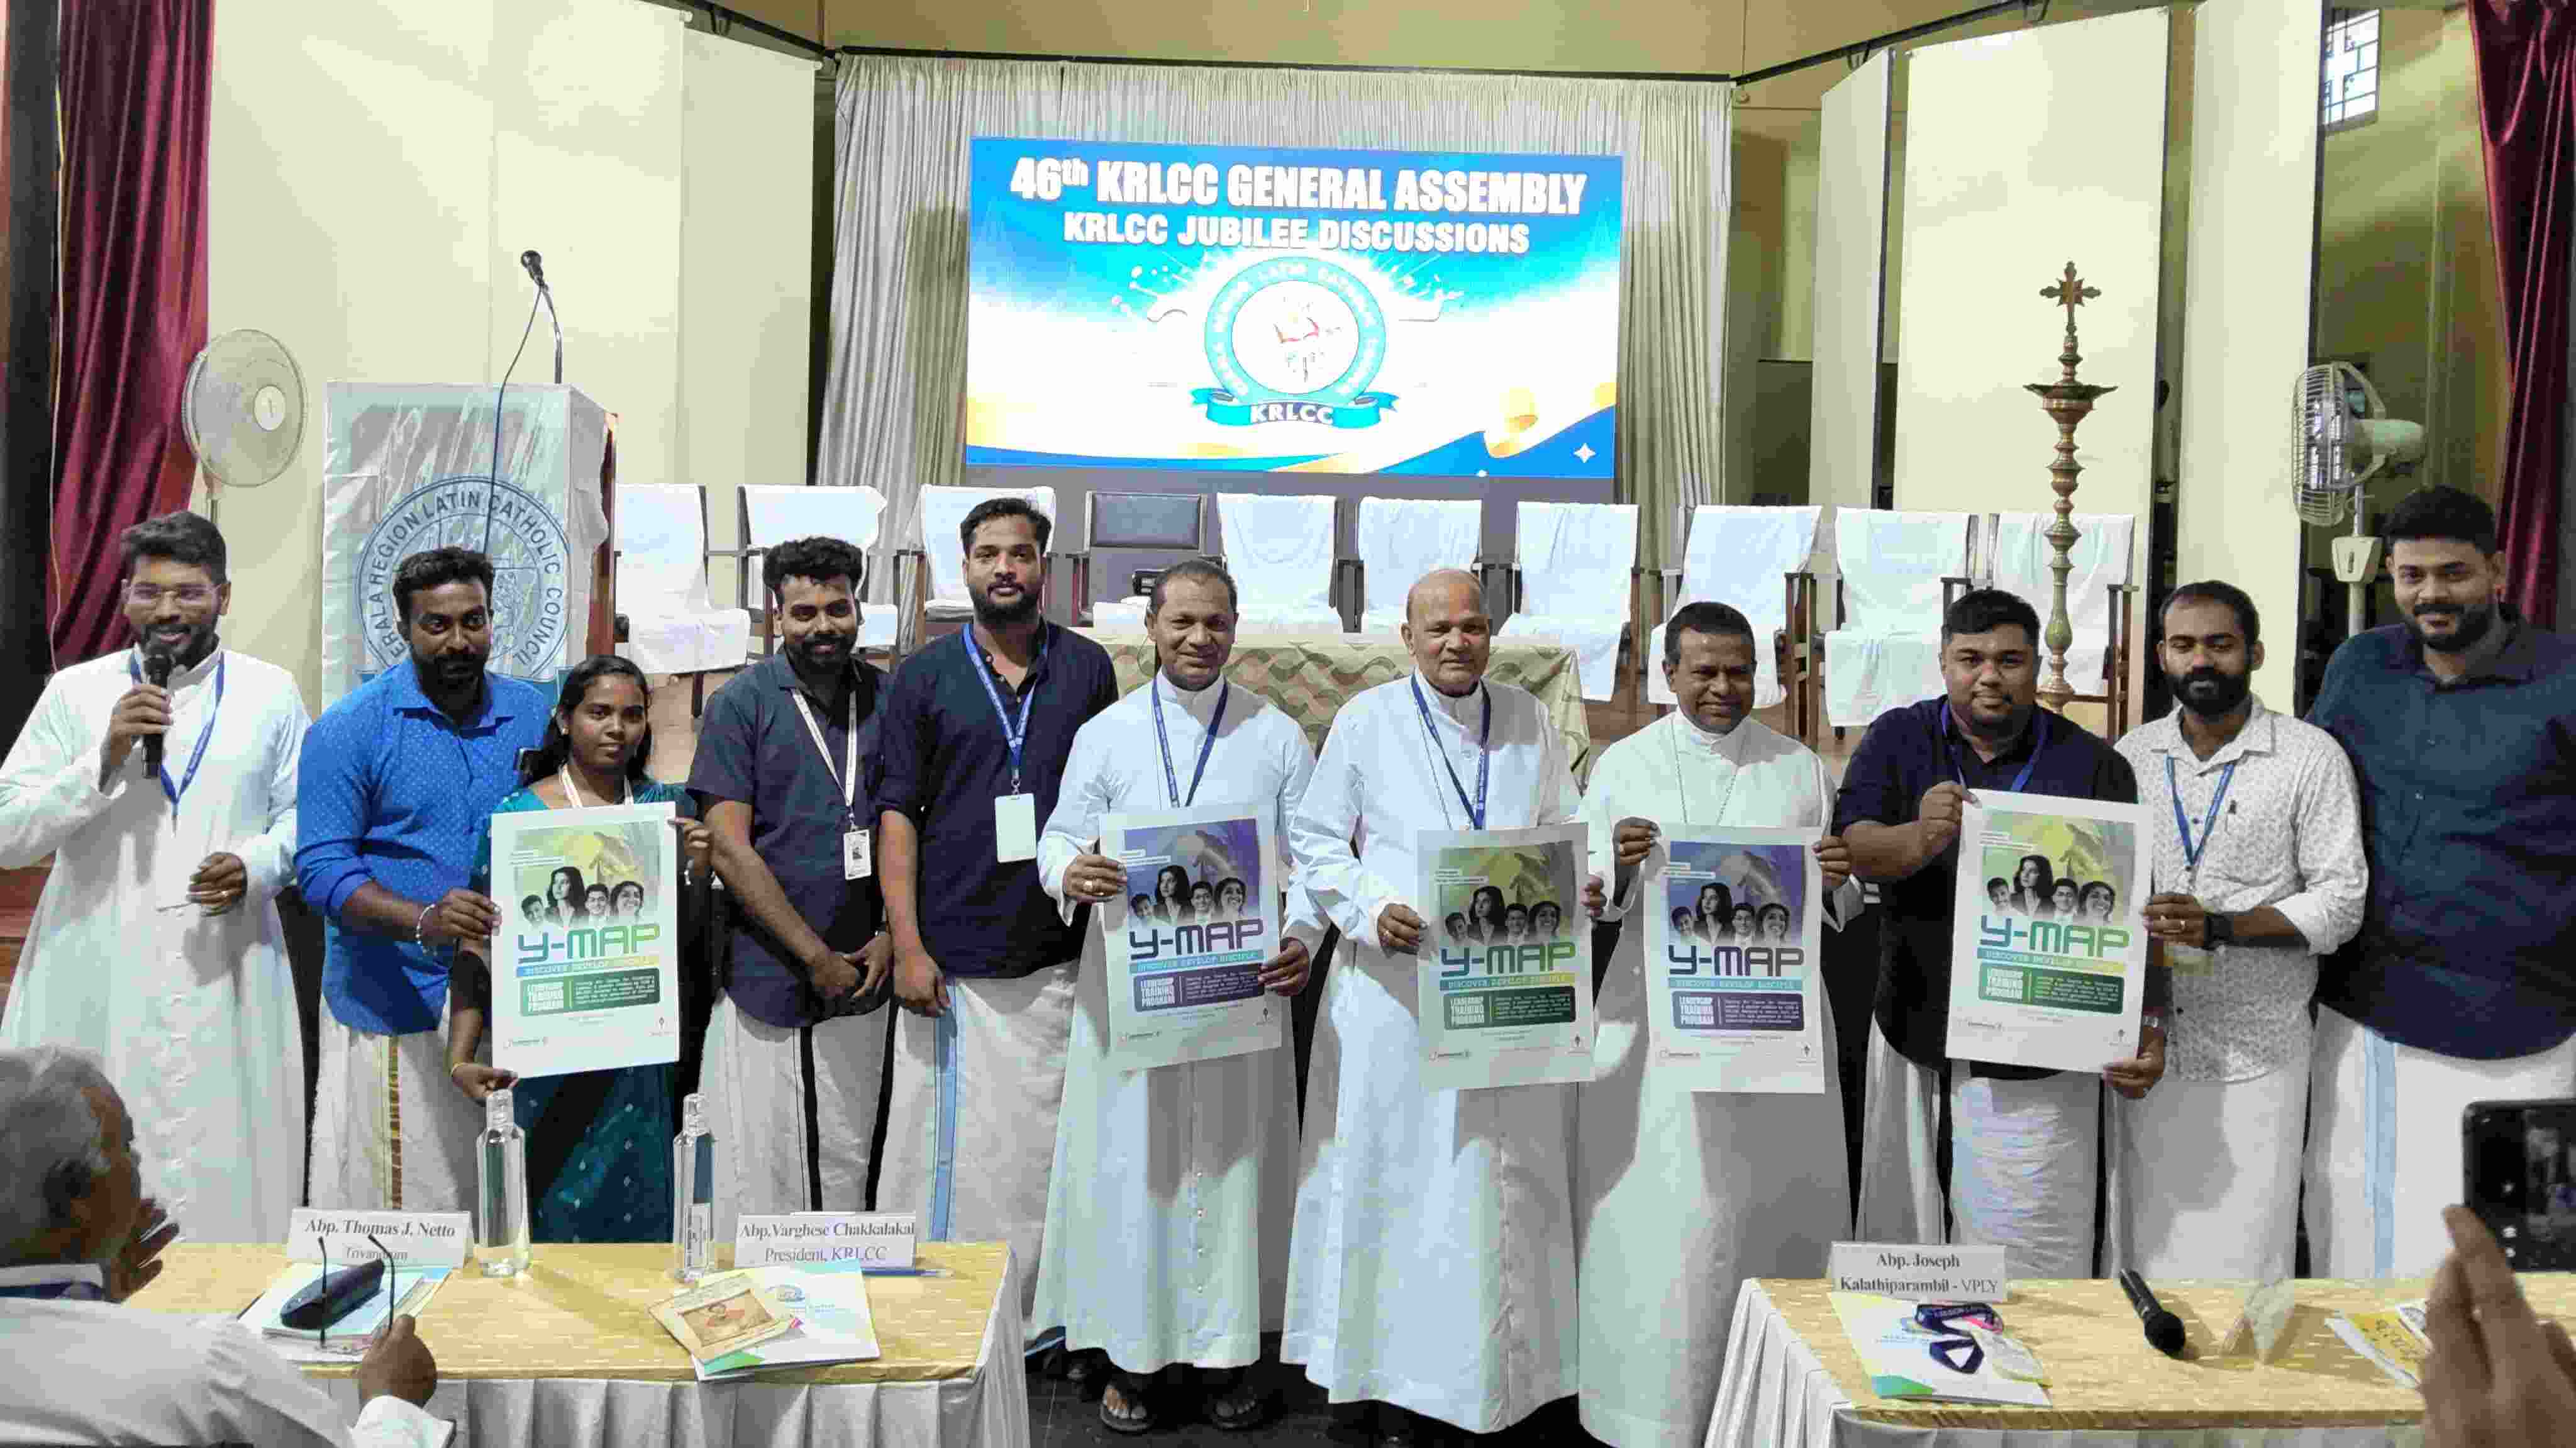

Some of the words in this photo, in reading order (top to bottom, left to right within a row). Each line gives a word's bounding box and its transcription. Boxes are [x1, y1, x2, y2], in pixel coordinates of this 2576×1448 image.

[1010, 156, 1089, 200] 46th
[1097, 162, 1219, 206] KRLCC
[1227, 165, 1387, 211] GENERAL
[1394, 170, 1587, 216] ASSEMBLY
[1063, 211, 1169, 245] KRLCC
[1177, 214, 1308, 250] JUBILEE
[1318, 219, 1530, 254] DISCUSSIONS
[1250, 403, 1334, 425] KRLCC
[422, 491, 480, 518] LATIN
[490, 494, 561, 575] CATHOLIC
[367, 513, 422, 586] REGION
[368, 592, 404, 659] ERALA
[513, 586, 563, 666] COUNCIL
[305, 1218, 338, 1237] Abp.
[343, 1219, 398, 1235] Thomas
[400, 1222, 413, 1237] J.
[418, 1222, 456, 1238] Netto
[834, 1222, 915, 1237] Chakkalakal
[831, 1246, 888, 1261] KRLCC
[1912, 1252, 1960, 1271] Joseph
[1841, 1277, 1950, 1295] Kalathiparambil
